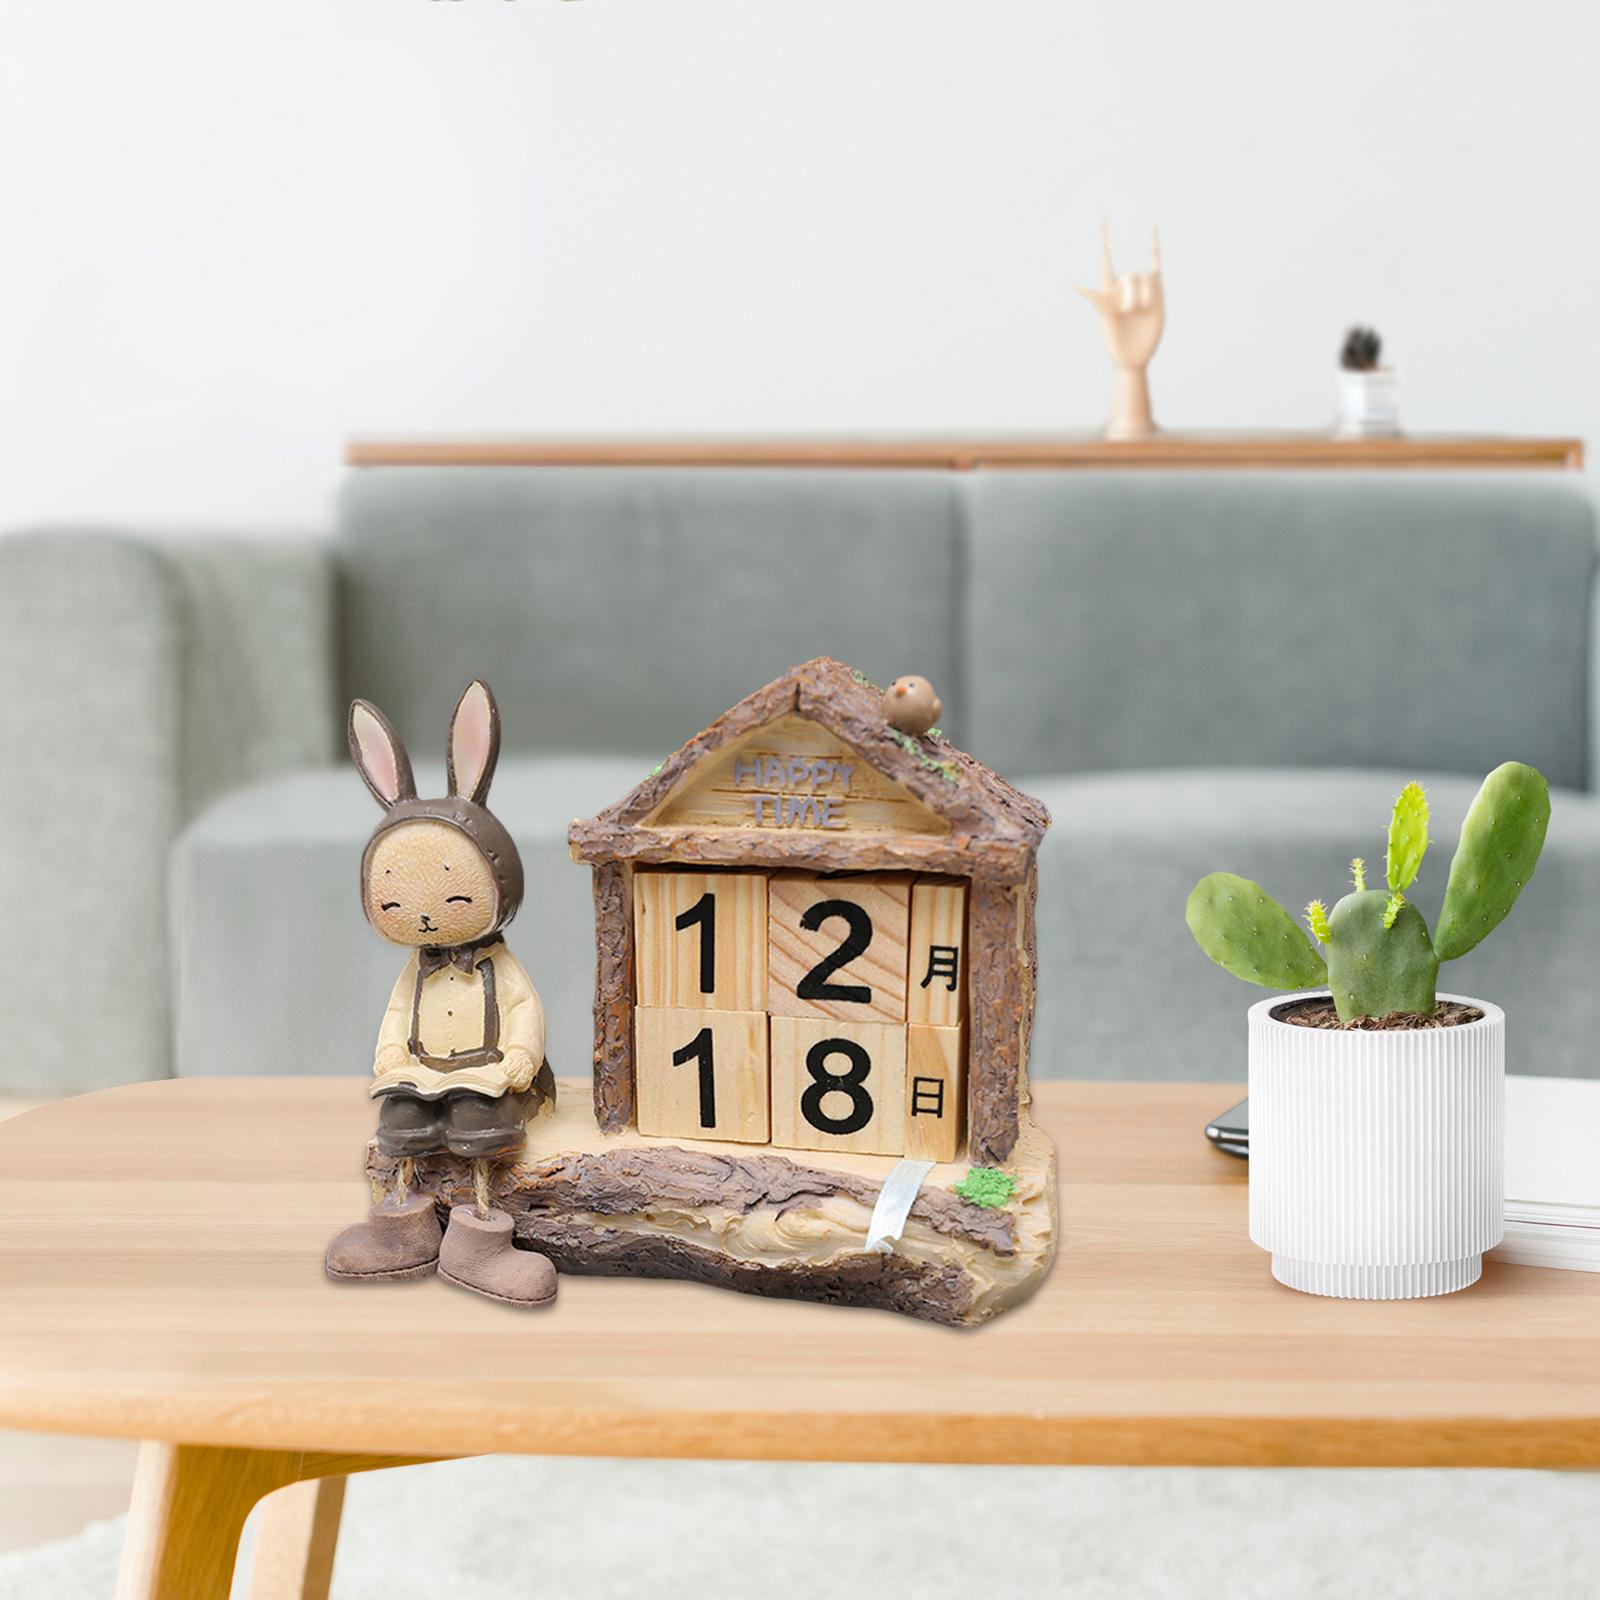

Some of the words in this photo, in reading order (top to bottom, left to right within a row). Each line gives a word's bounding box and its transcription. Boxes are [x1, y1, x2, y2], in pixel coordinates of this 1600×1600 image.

[735, 756, 855, 791] HAPPY
[750, 795, 845, 828] TIME
[919, 944, 960, 992] 月
[911, 1076, 945, 1119] 日
